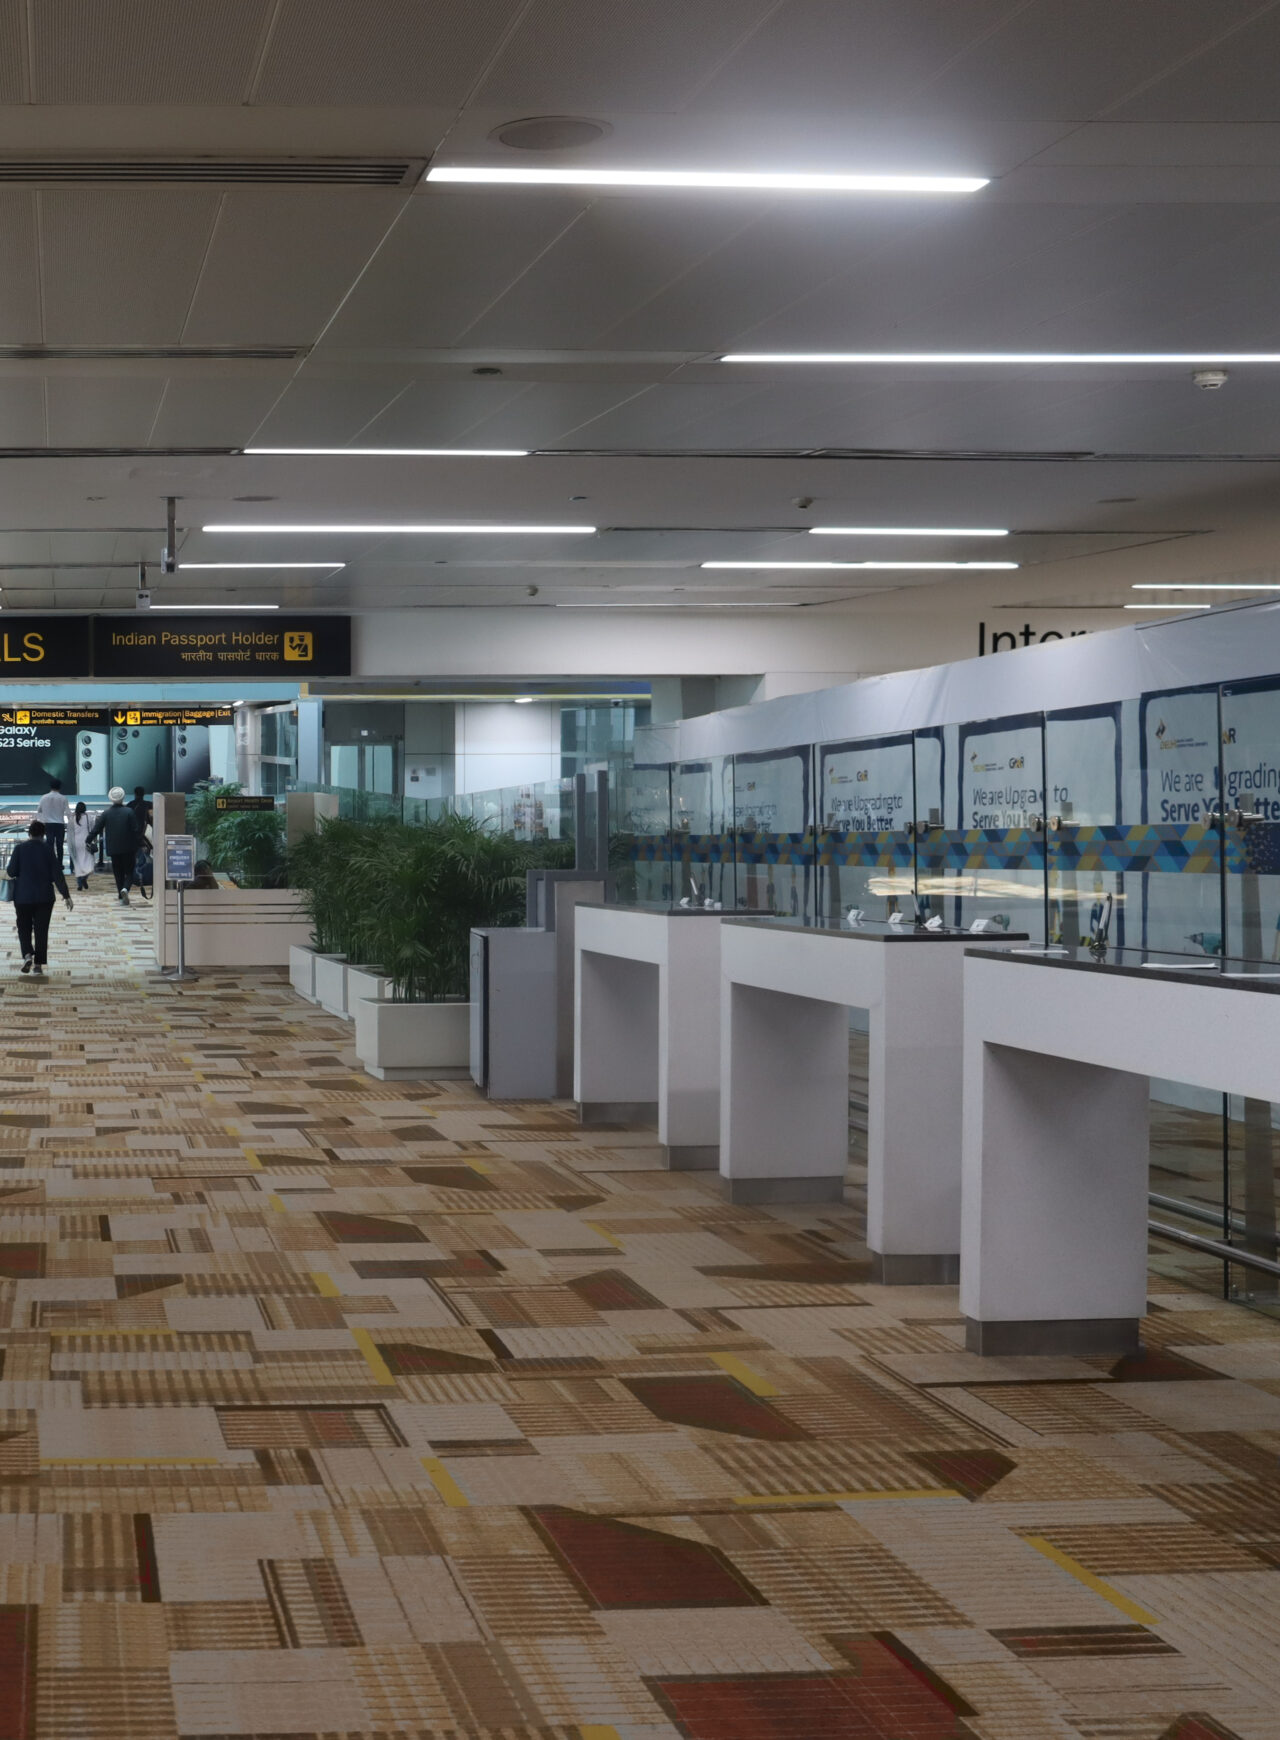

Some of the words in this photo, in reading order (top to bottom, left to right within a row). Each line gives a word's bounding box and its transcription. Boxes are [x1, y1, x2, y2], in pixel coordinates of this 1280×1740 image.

[112, 632, 156, 646] Indian
[161, 632, 227, 647] Passport
[232, 632, 280, 645] Holder
[181, 651, 213, 662] भारतीय
[218, 650, 251, 661] पासपोर्ट
[255, 652, 280, 661] धारक
[31, 710, 65, 718] Domestic
[141, 710, 181, 719] Immigration
[184, 710, 215, 718] Baggage
[217, 709, 231, 717] Exit
[16, 737, 52, 748] Series
[1160, 769, 1181, 792] We
[1184, 773, 1204, 792] are
[973, 787, 988, 806] We
[988, 790, 1004, 806] are
[1053, 784, 1068, 803] to
[1160, 798, 1200, 822] Serve
[851, 815, 866, 832] You
[972, 810, 1000, 829] Serve
[1001, 809, 1020, 828] You
